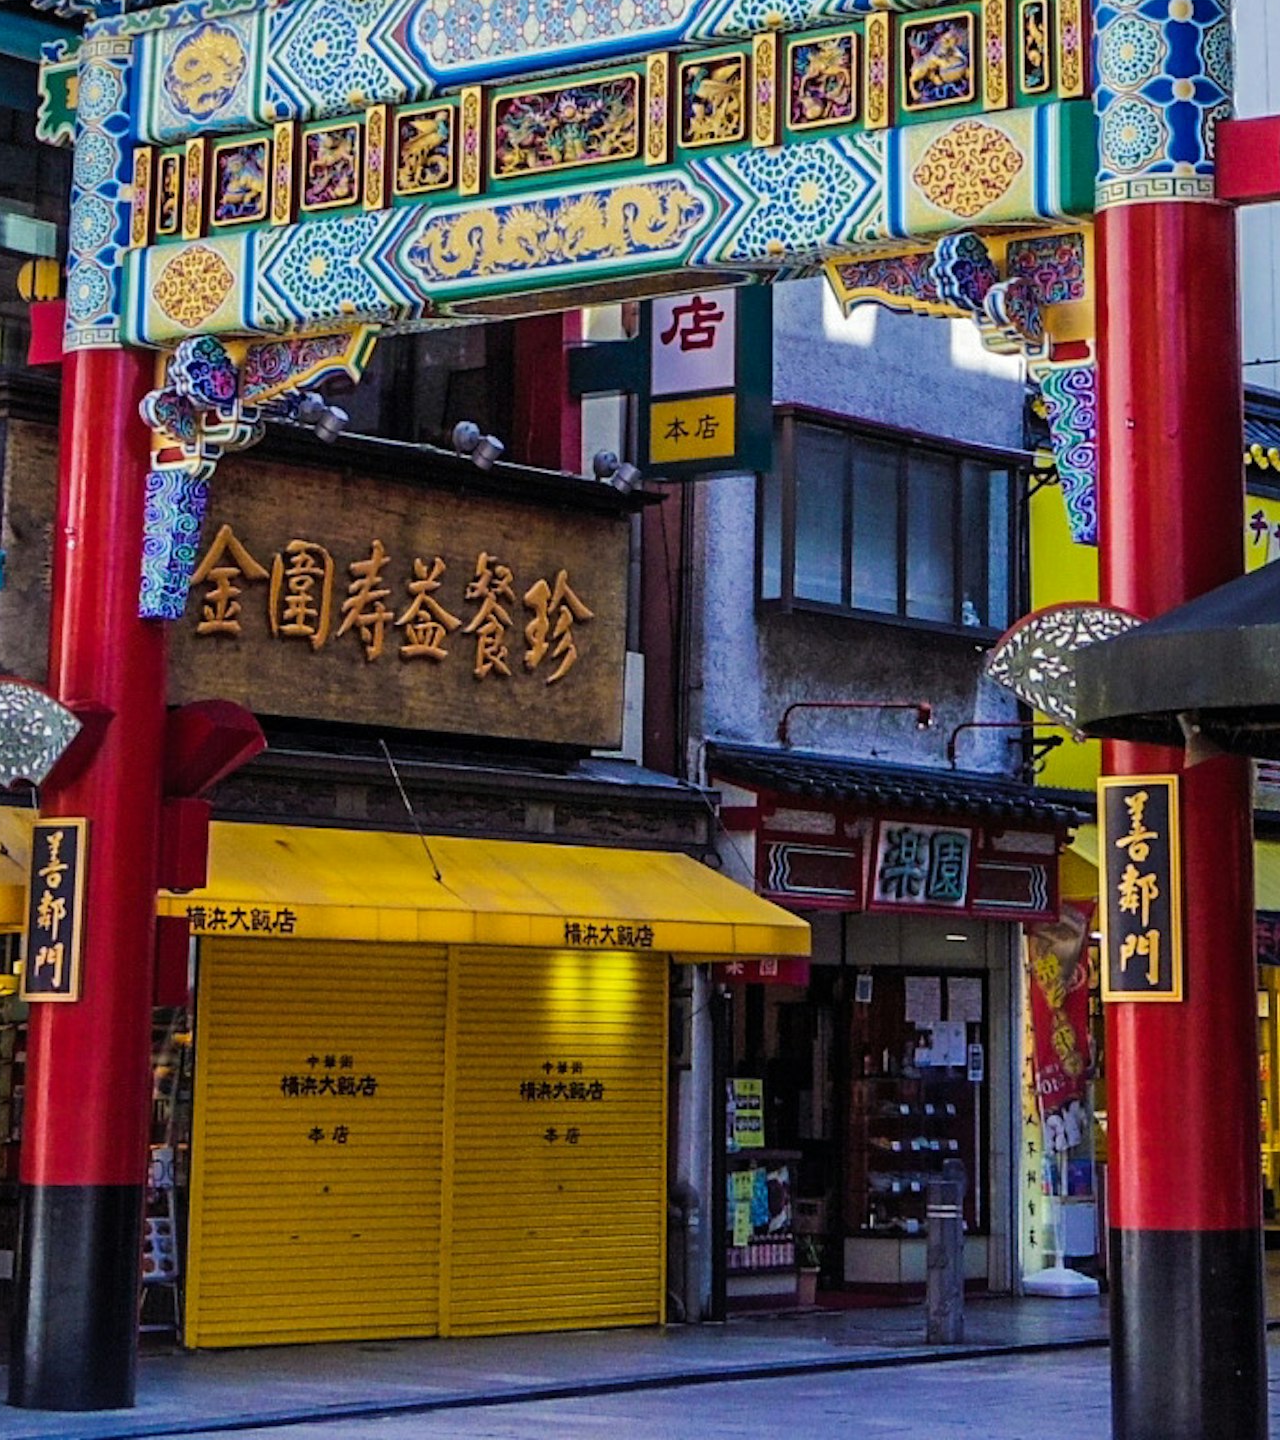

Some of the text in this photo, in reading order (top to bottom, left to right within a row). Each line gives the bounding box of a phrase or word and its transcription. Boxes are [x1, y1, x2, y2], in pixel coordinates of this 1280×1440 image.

[660, 295, 725, 353] 店
[663, 412, 720, 444] 本店
[880, 827, 968, 901] 楽園
[186, 906, 298, 935] 横浜大飯店
[564, 921, 655, 948] 横浜大飯店
[280, 1074, 378, 1098] 横浜大飯店
[519, 1080, 605, 1102] 横浜大飯店
[307, 1125, 350, 1145] 本店
[543, 1126, 581, 1145] 本店
